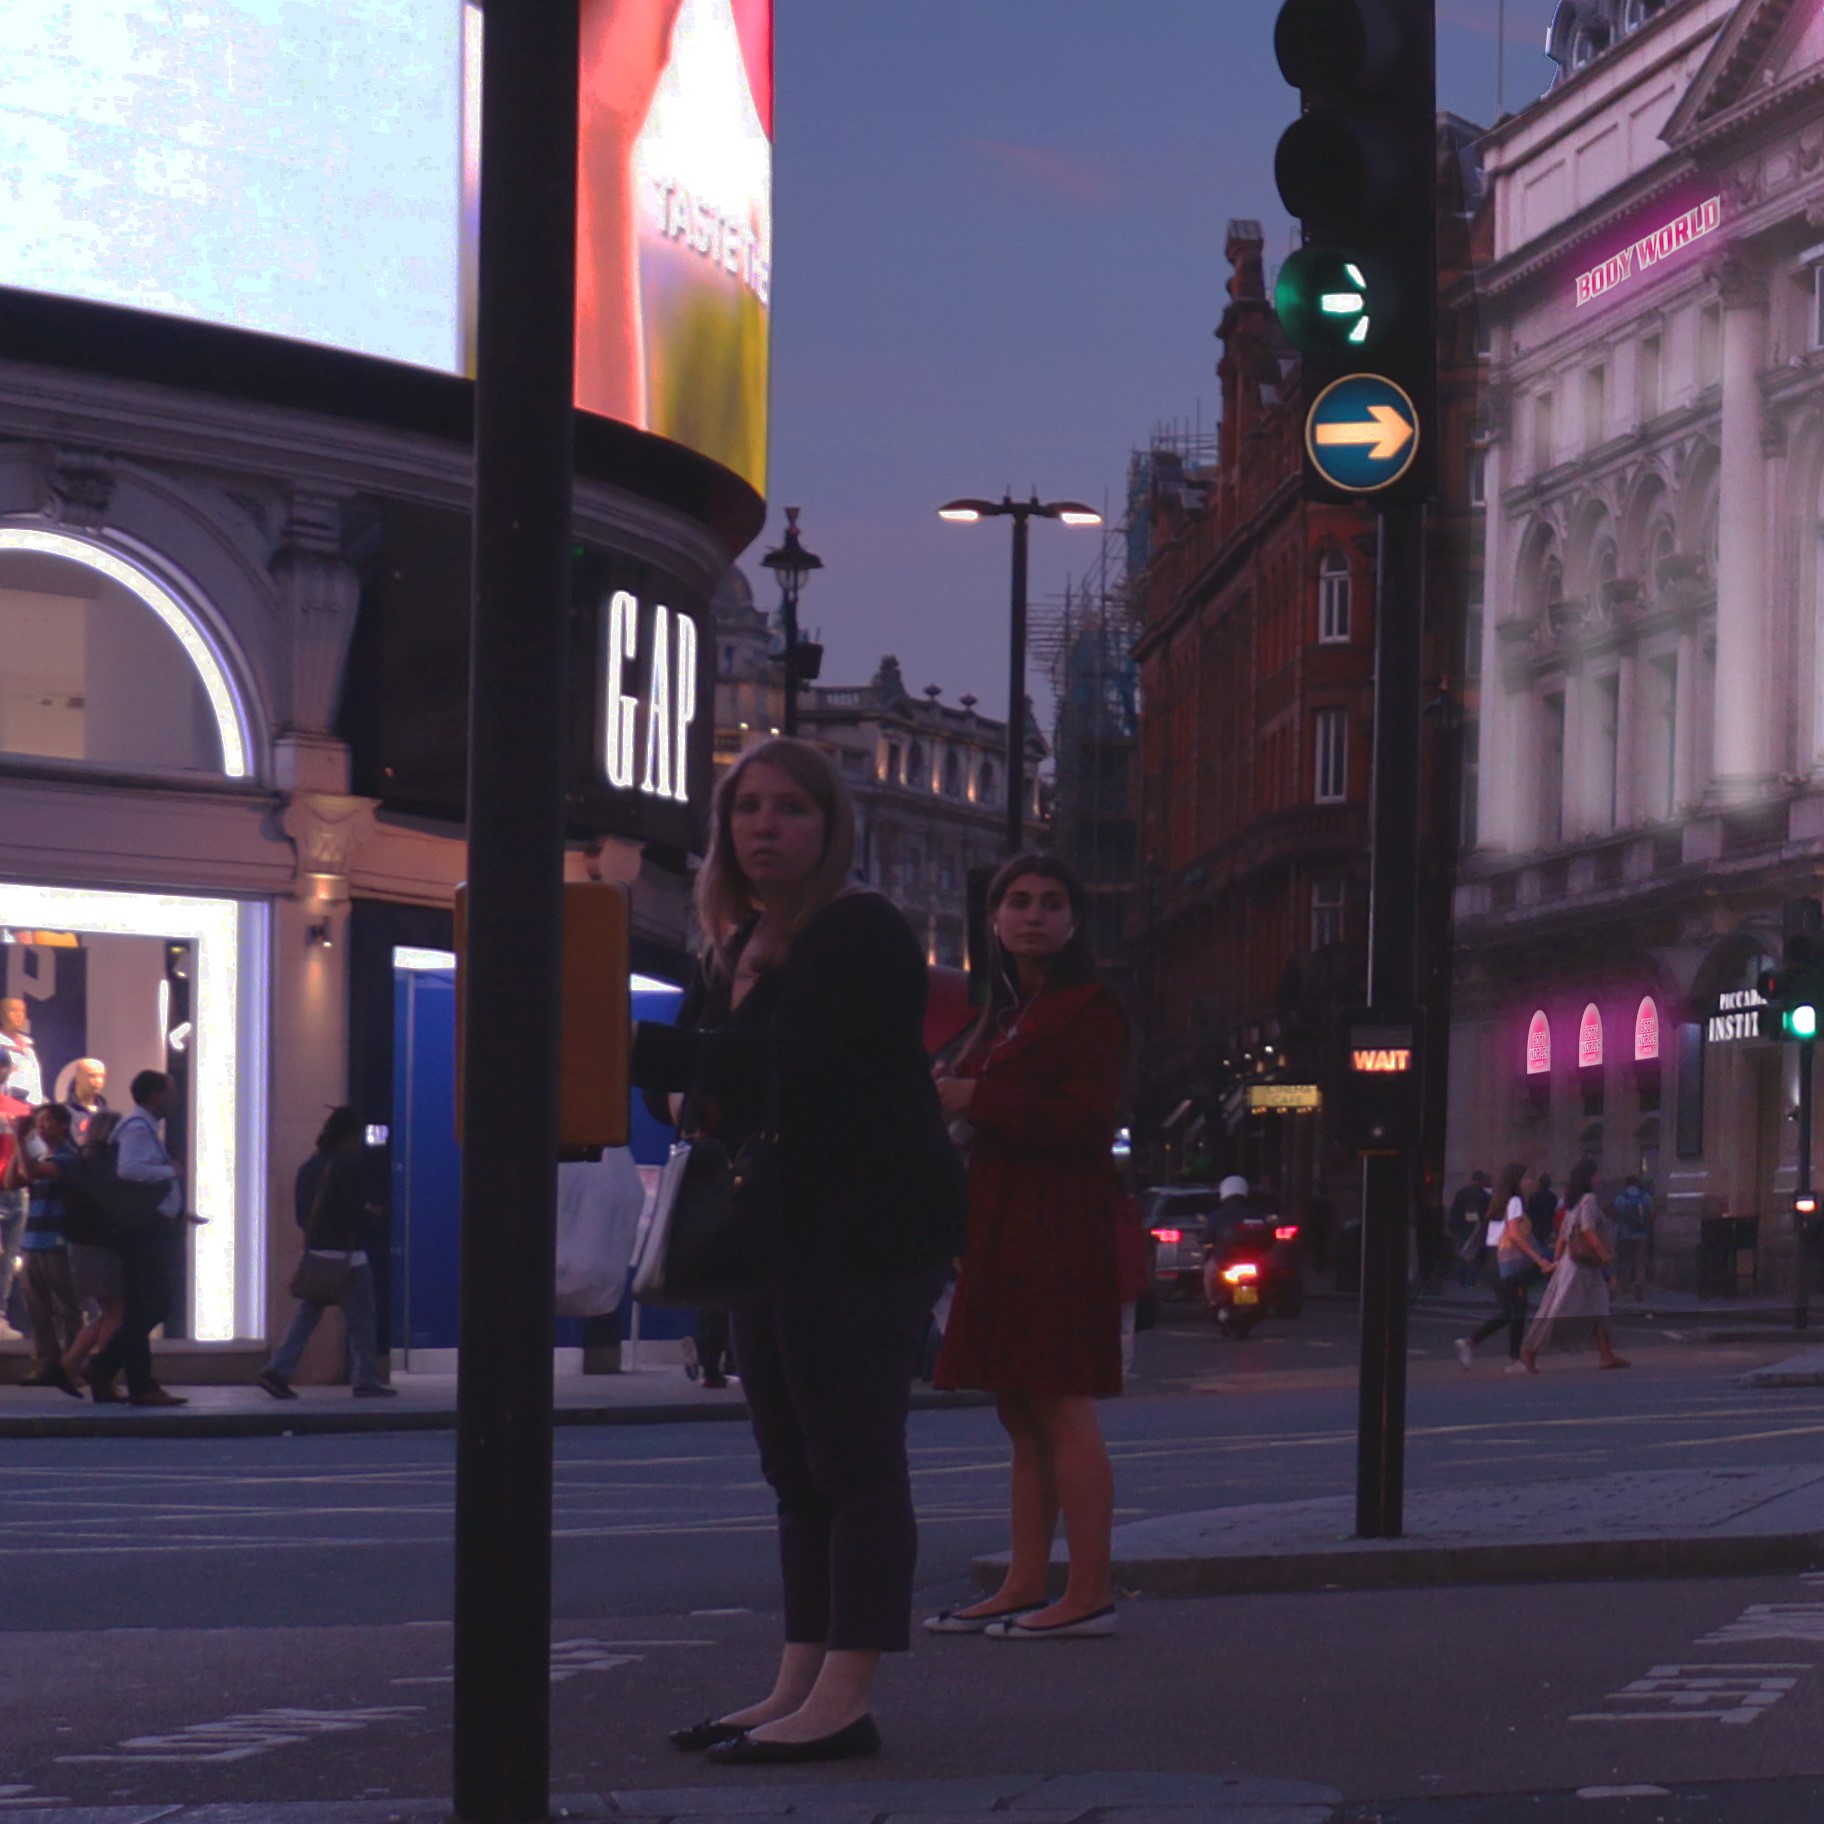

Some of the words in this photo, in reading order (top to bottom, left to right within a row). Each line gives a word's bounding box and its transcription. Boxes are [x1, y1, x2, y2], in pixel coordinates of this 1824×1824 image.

[1576, 246, 1634, 308] BODY
[1636, 194, 1720, 271] WORLD
[607, 590, 697, 803] GAP
[1720, 988, 1767, 1010] PICCAD
[1709, 1011, 1759, 1042] INSTIT
[1353, 1049, 1411, 1071] WAIT
